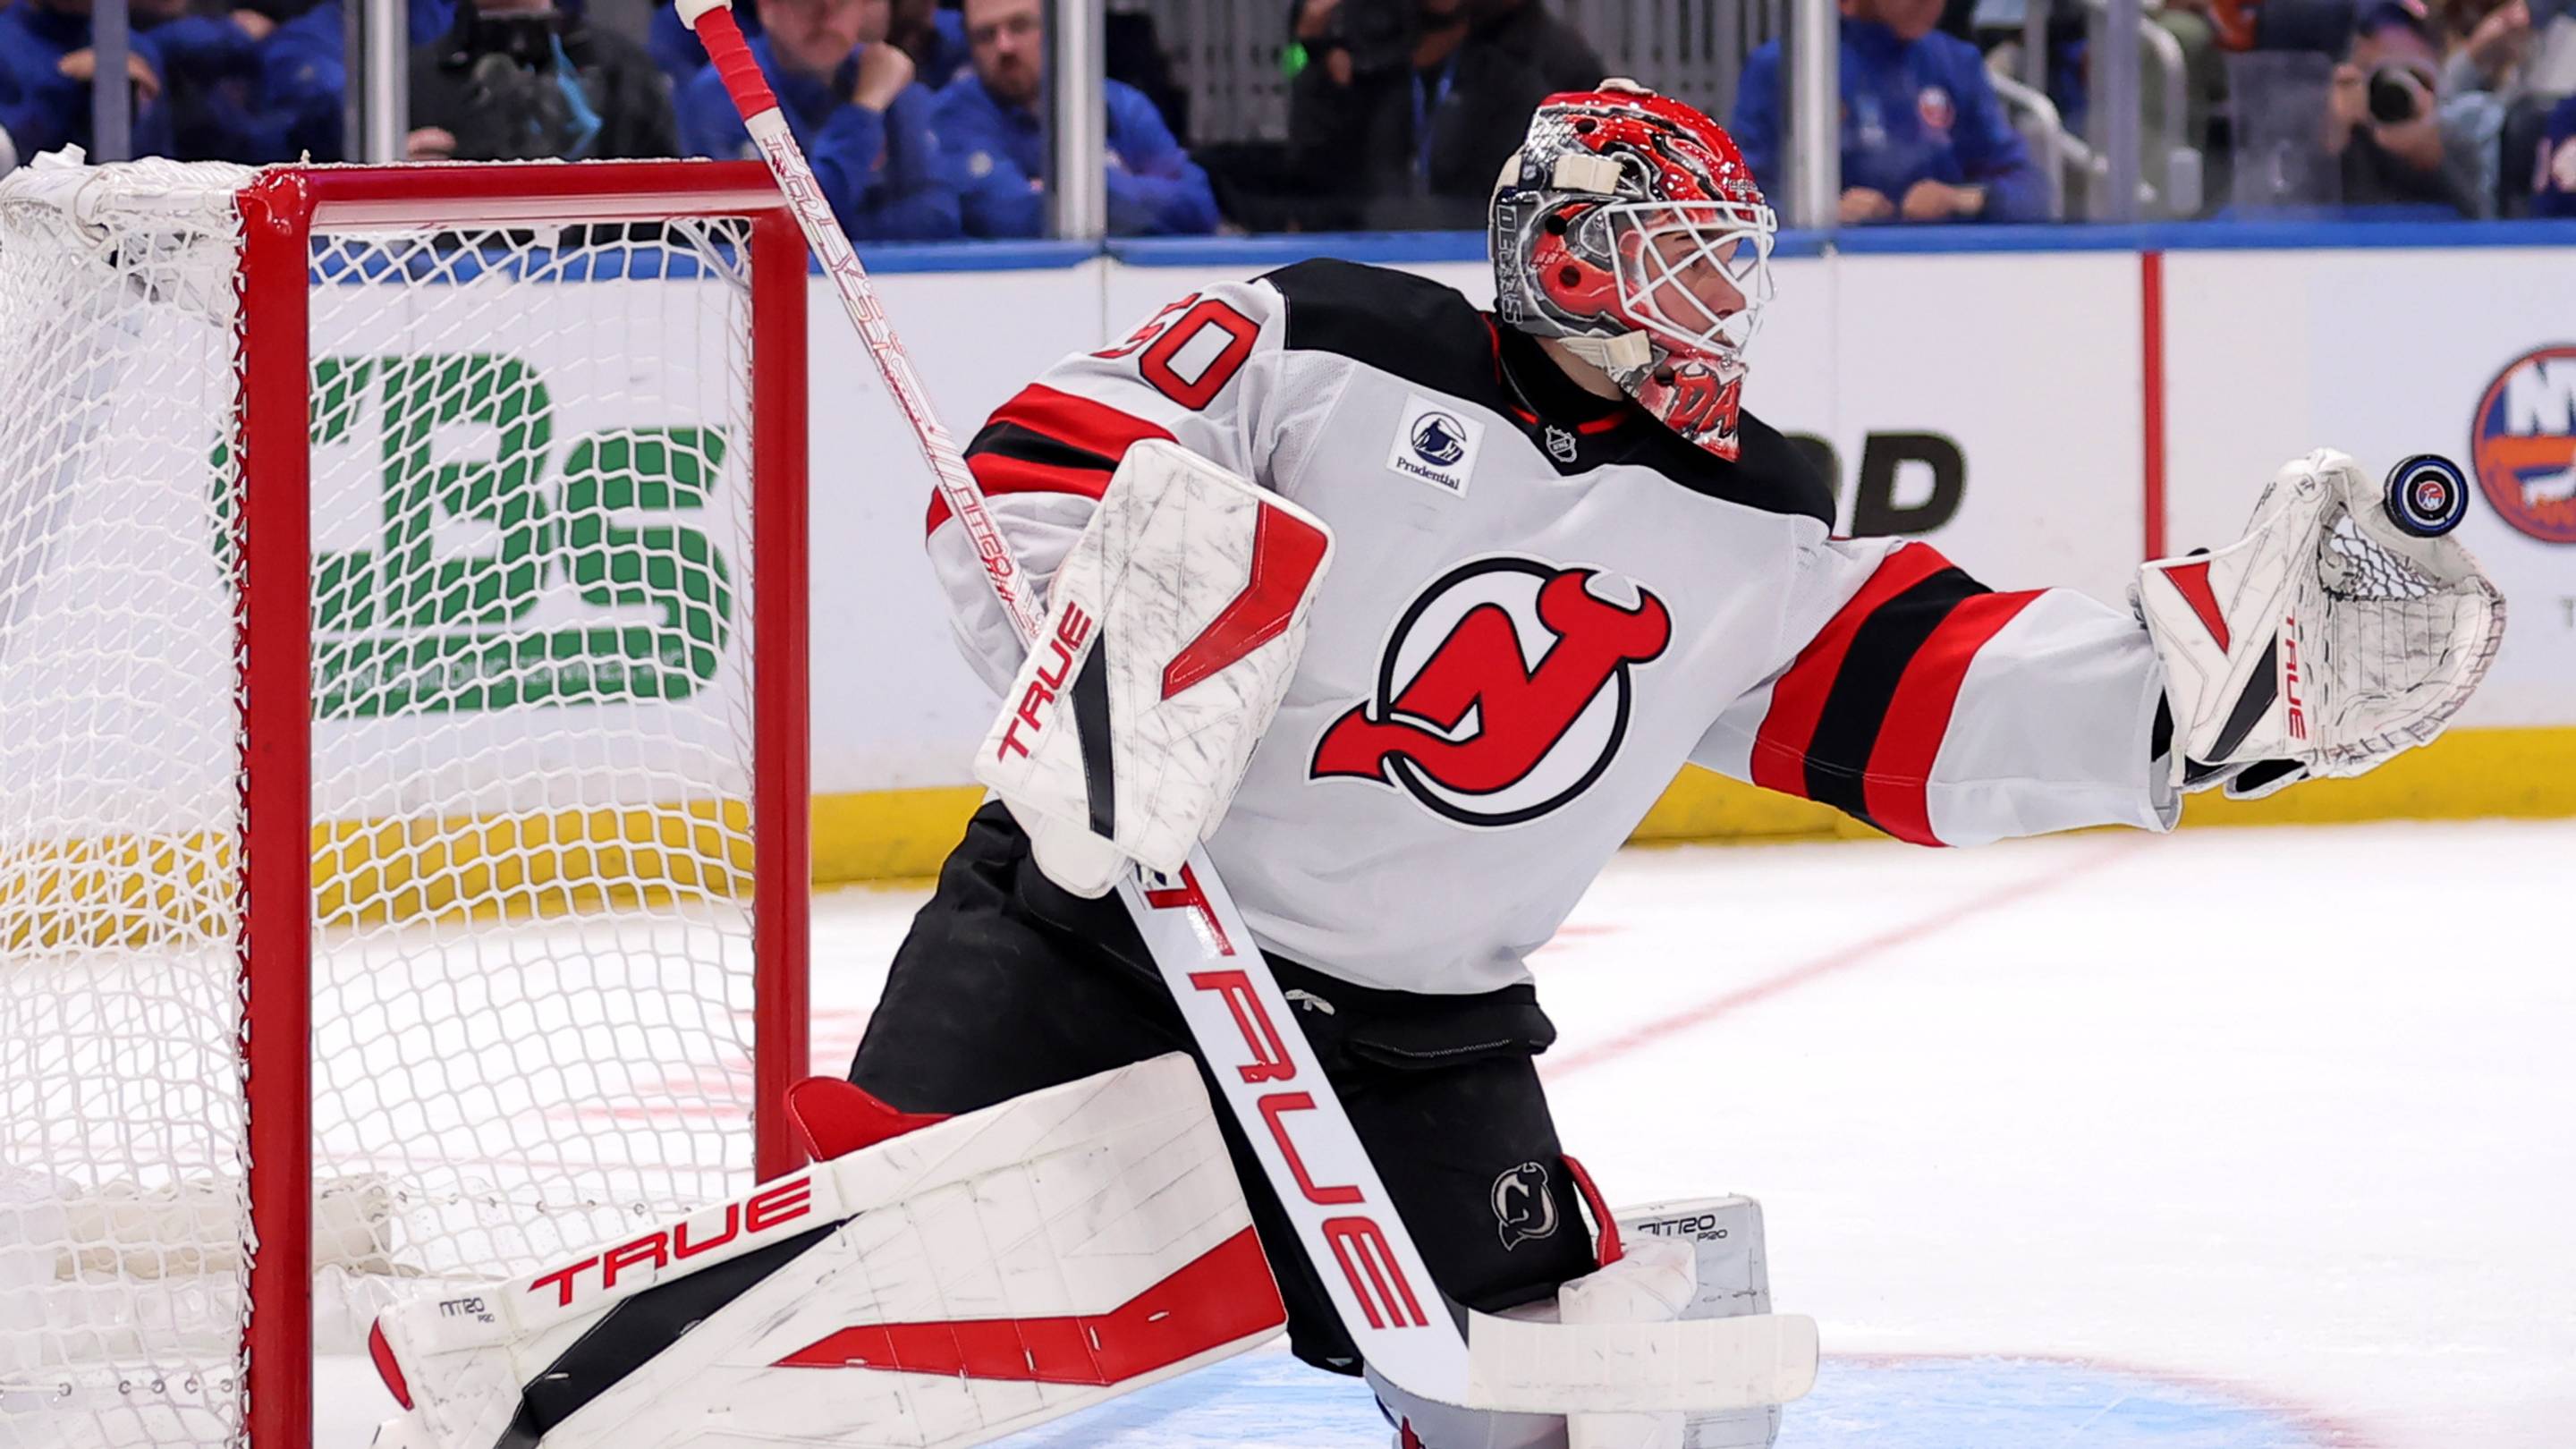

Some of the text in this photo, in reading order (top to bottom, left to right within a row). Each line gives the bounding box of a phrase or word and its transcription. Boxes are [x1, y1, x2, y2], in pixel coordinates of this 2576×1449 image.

[1396, 456, 1461, 491] Prudential
[997, 600, 1092, 763] TRUE
[2285, 606, 2307, 741] TRUE
[1144, 861, 1430, 1330] TRUE
[526, 1167, 811, 1308] TRUE
